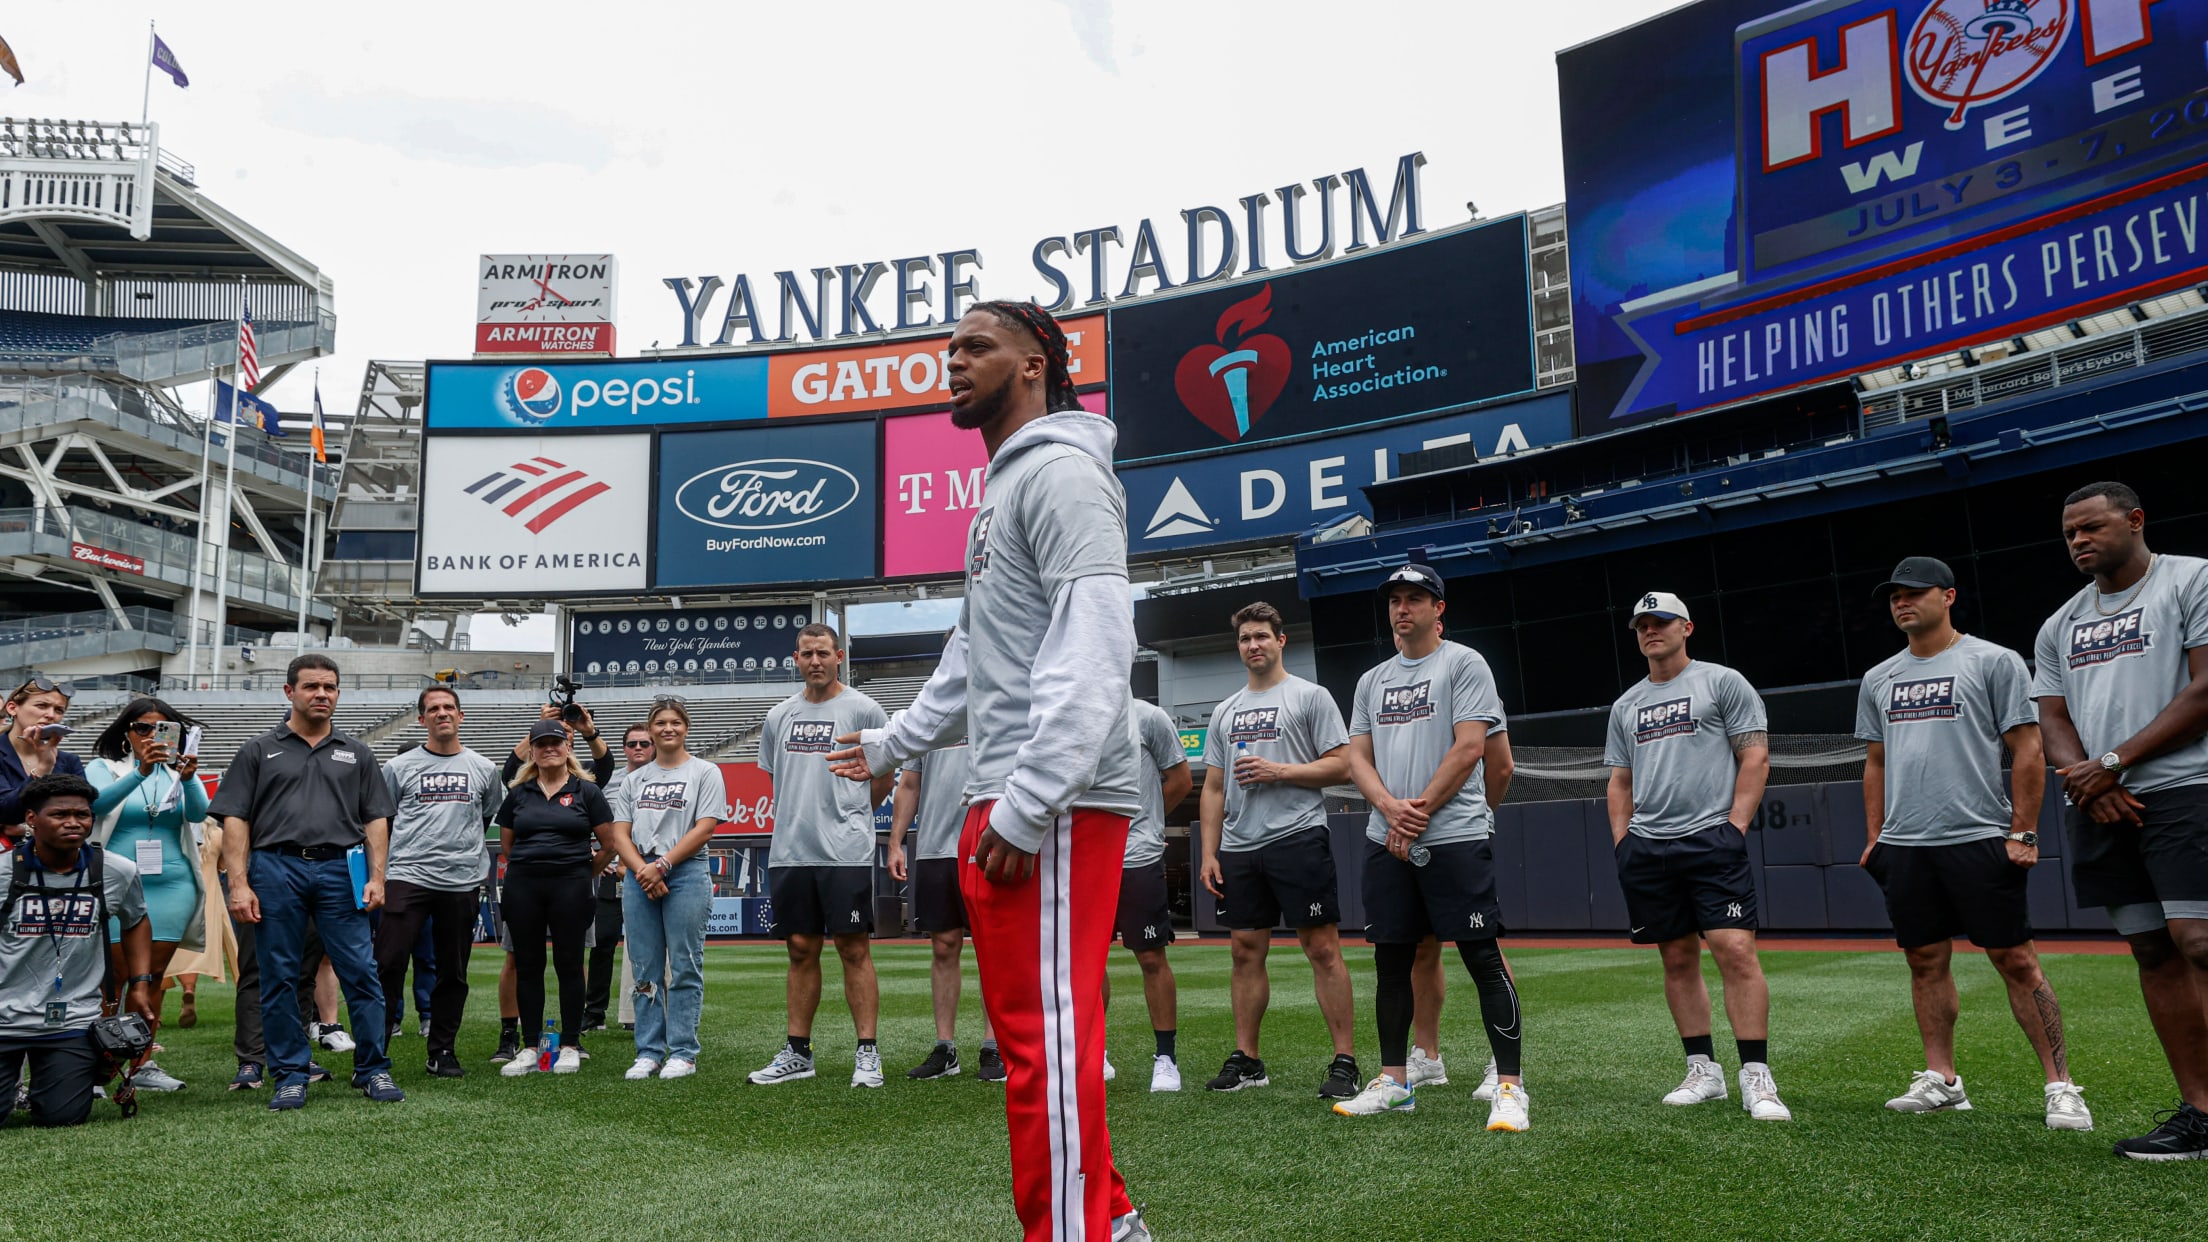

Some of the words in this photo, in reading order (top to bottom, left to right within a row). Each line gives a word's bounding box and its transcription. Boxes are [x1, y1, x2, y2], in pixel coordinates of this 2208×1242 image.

[1911, 14, 2068, 88] Yankees
[1848, 174, 1974, 237] JULY
[1995, 161, 2023, 189] 3
[662, 248, 984, 347] YANKEE
[1031, 150, 1427, 310] STADIUM
[484, 264, 606, 280] ARMITRON
[487, 326, 597, 342] ARMITRON
[1698, 303, 1851, 395] HELPING
[1873, 254, 2019, 347] OTHERS
[541, 341, 595, 350] WATCHES
[1311, 323, 1416, 358] American
[1312, 352, 1377, 380] Heart
[571, 369, 696, 416] pepsi
[1313, 365, 1440, 401] Association
[1954, 375, 2028, 400] Matercard
[707, 468, 827, 518] Ford
[899, 472, 932, 515] T
[706, 534, 826, 553] BuyFordNow.com
[72, 545, 142, 571] Budweiser
[427, 555, 492, 570] BANK
[500, 554, 528, 569] OF
[535, 552, 641, 569] AMERICA
[2074, 612, 2139, 645] HOPE
[642, 638, 668, 650] New
[669, 637, 697, 656] York
[697, 636, 741, 656] Yankees
[1385, 684, 1428, 705] HOPE
[1894, 681, 1951, 702] HOPE
[1901, 697, 1941, 707] WEEK
[1234, 710, 1276, 726] HOPE
[1640, 701, 1688, 724] HOPE
[792, 724, 833, 737] HOPE
[422, 775, 466, 788] HOPE
[644, 784, 684, 797] HOPE
[26, 898, 92, 916] HOPE
[728, 912, 738, 921] at
